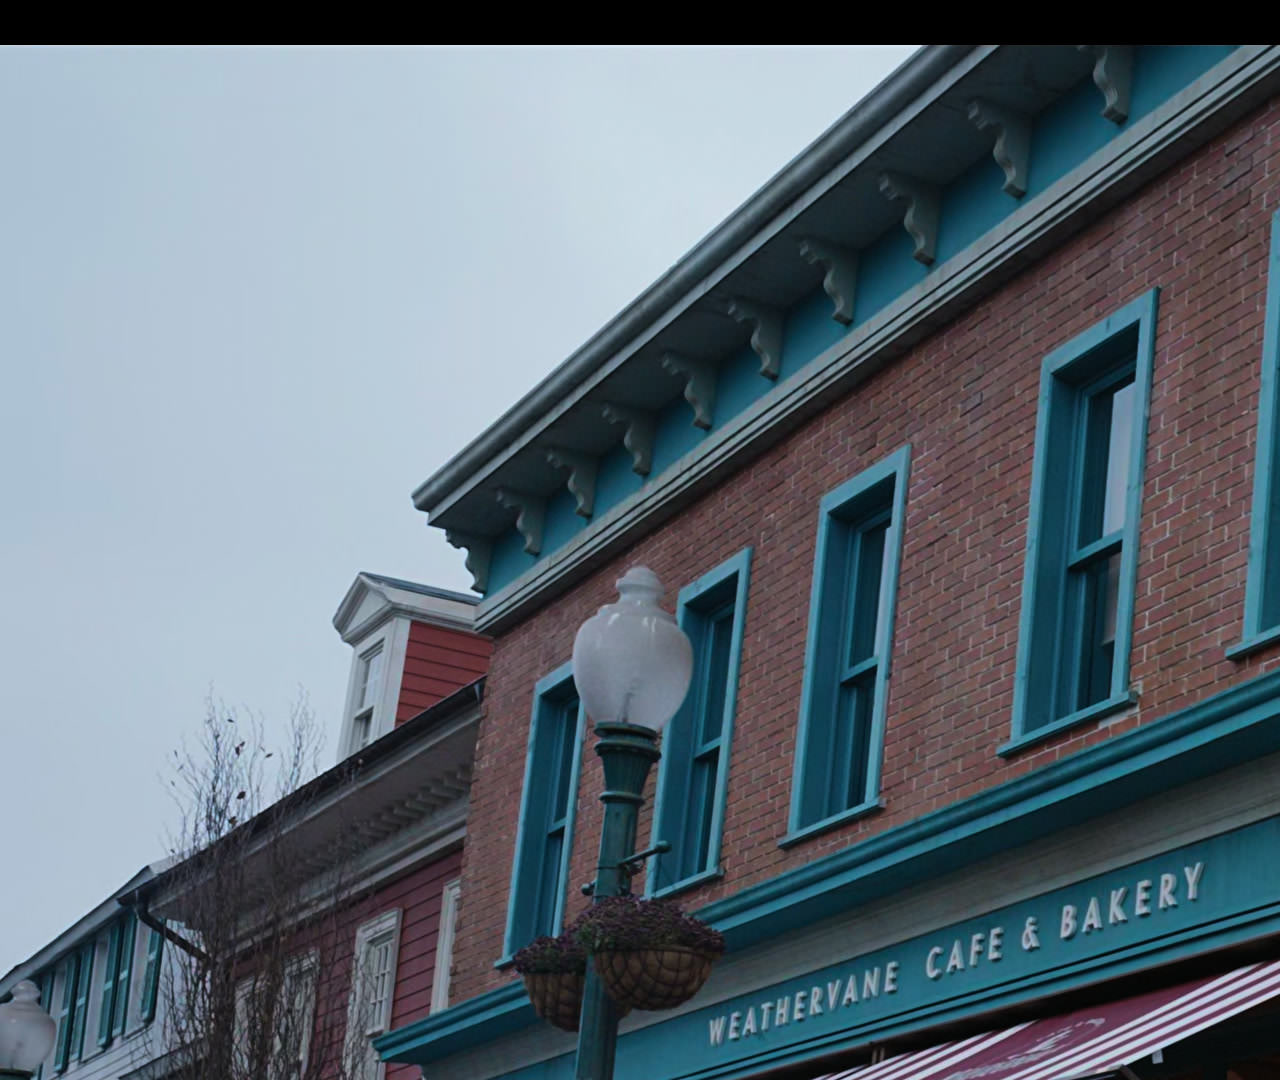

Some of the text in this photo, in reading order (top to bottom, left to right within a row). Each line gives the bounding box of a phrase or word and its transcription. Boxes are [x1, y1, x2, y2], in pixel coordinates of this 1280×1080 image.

[709, 862, 1203, 1046] WEATHERVANE CAFE & BAKERY
